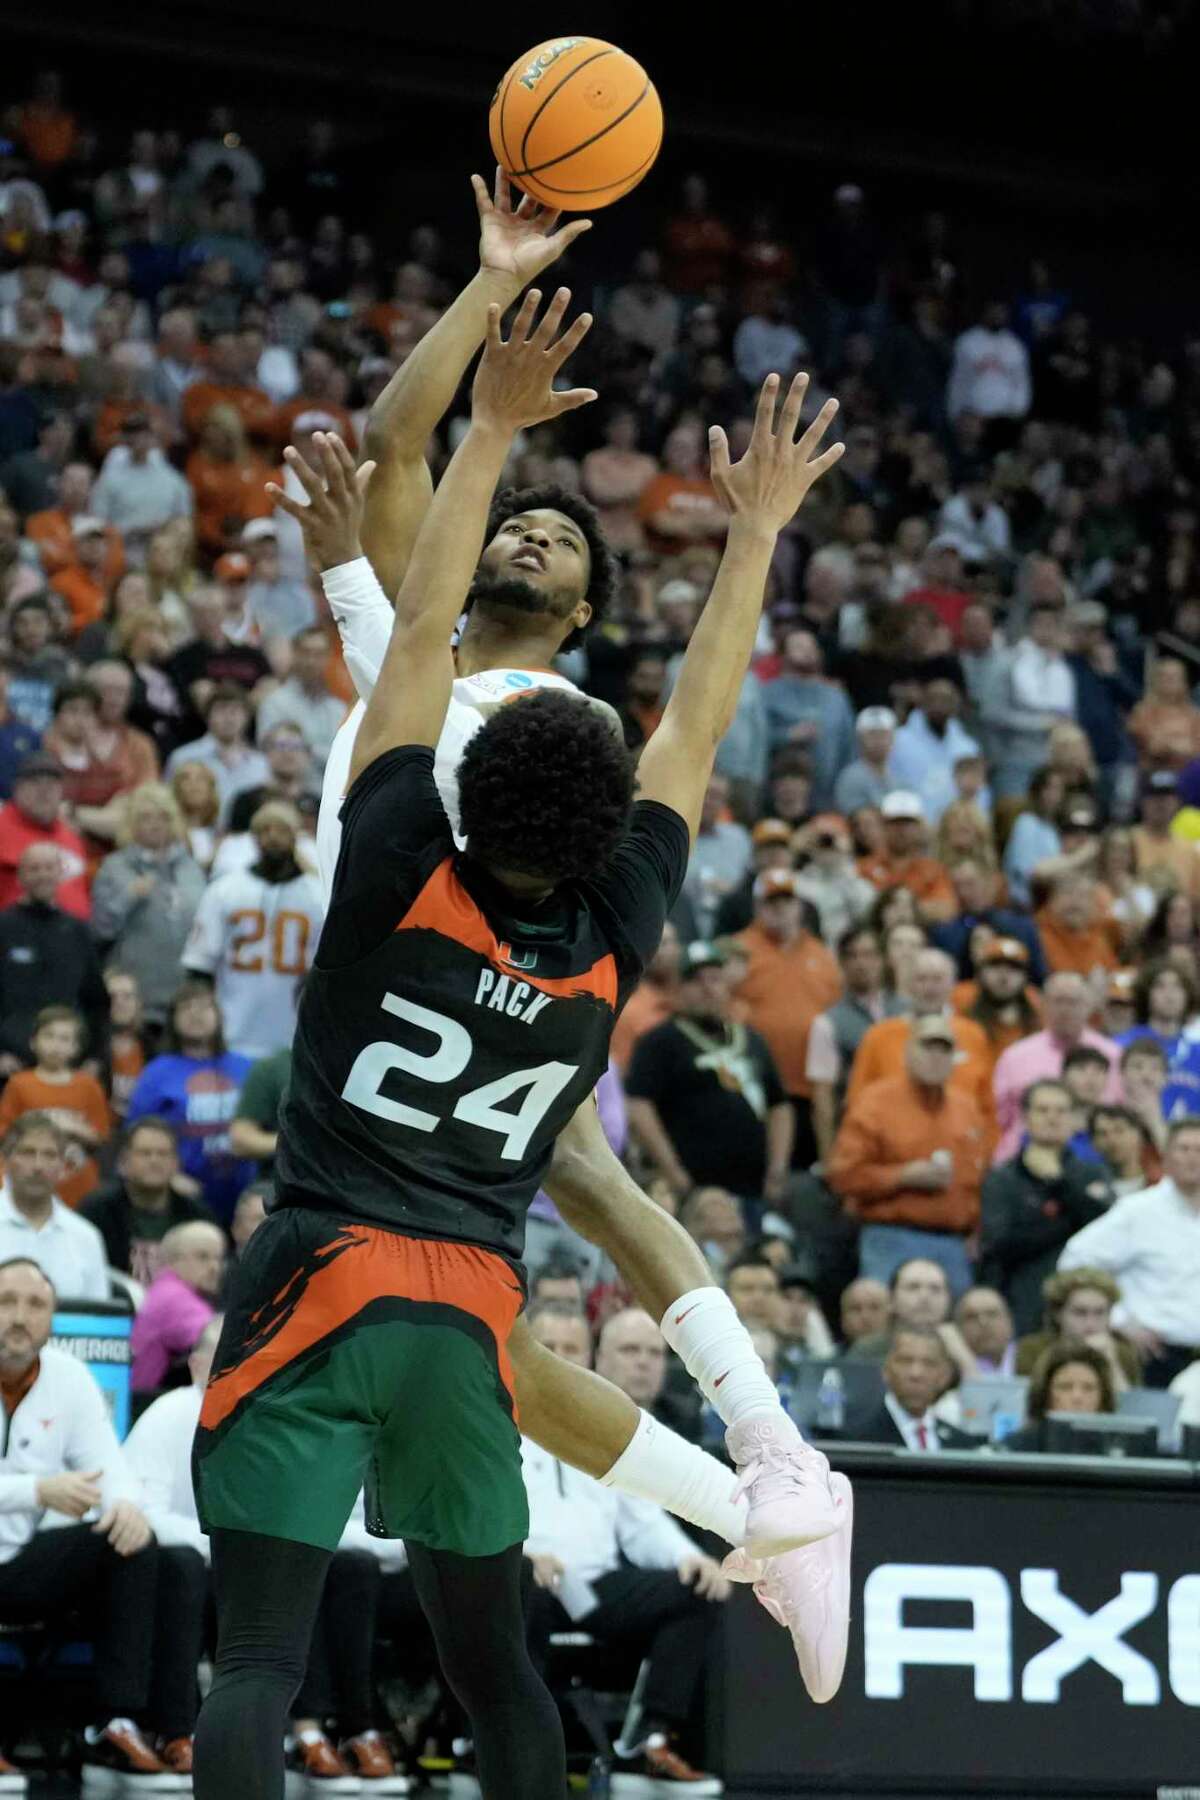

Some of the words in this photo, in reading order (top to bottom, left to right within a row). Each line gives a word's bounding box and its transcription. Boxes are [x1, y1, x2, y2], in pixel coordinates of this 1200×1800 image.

[225, 908, 311, 976] 20
[473, 967, 555, 1026] PACK
[341, 991, 580, 1162] 24
[863, 1563, 1200, 1707] AX
